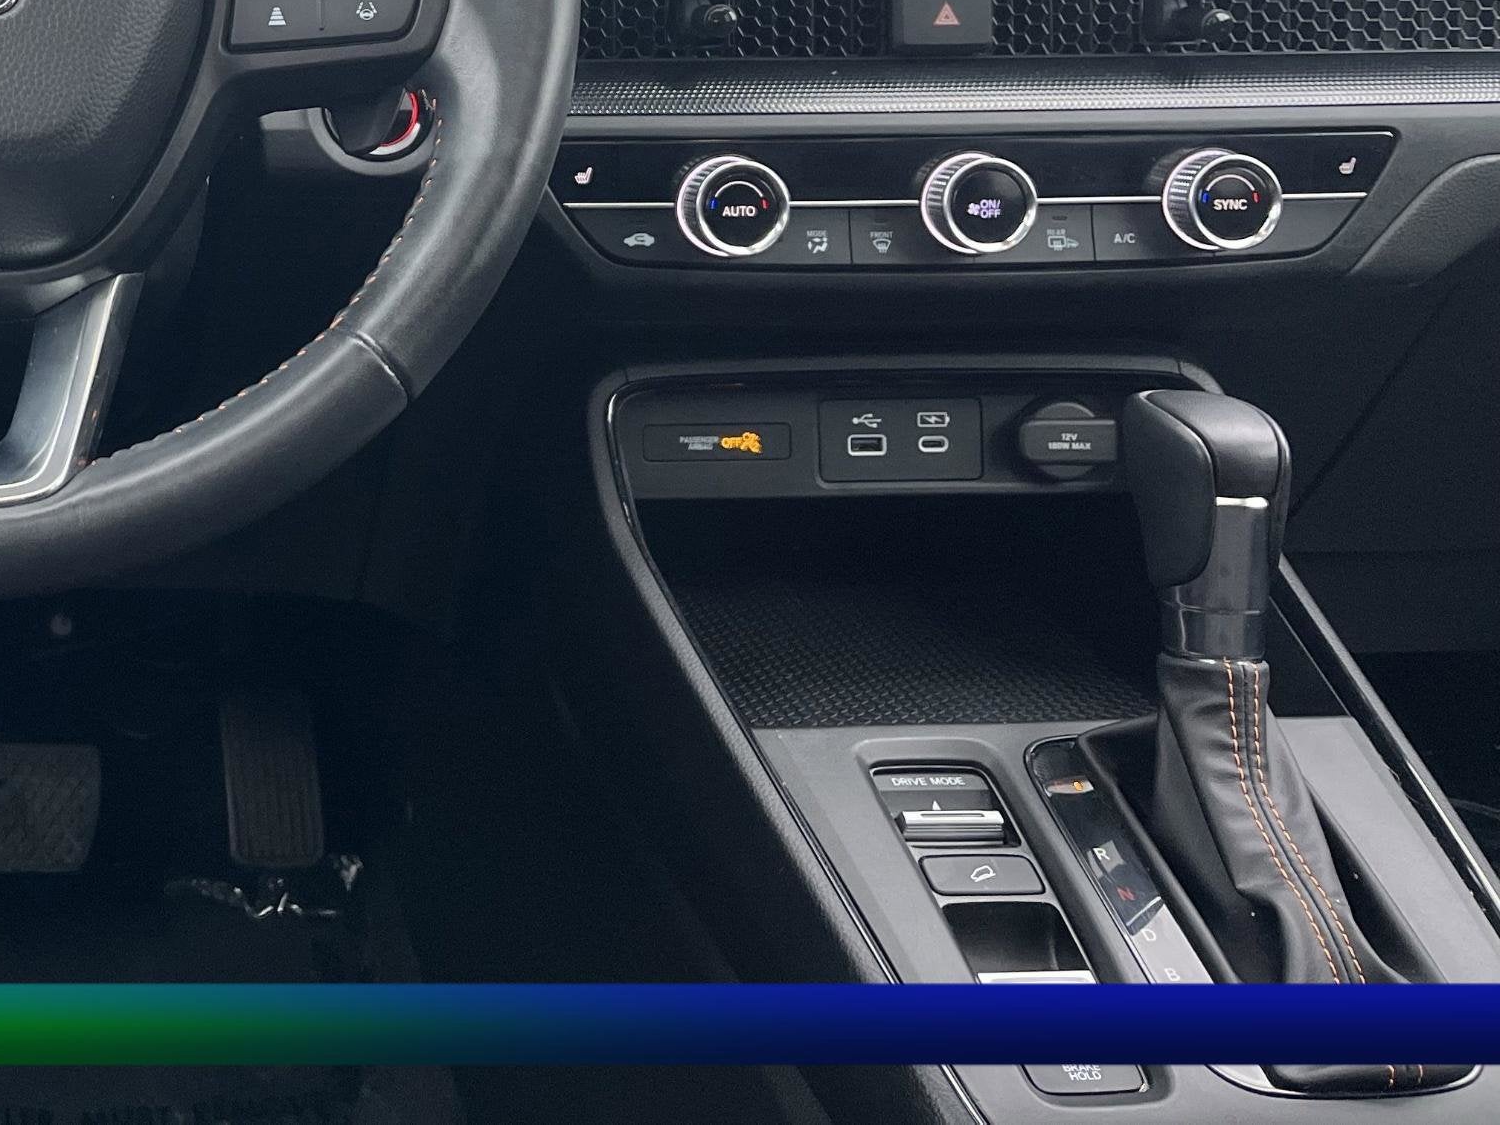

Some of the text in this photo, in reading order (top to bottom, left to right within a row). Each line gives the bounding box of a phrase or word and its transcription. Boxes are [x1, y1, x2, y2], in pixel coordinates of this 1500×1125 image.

[980, 199, 1001, 209] ON/
[1213, 198, 1248, 211] SYNC
[722, 205, 756, 217] AUTO
[980, 208, 1001, 218] OFF
[1113, 233, 1136, 244] A/C
[1061, 433, 1078, 441] 12V
[1071, 442, 1092, 450] MAX
[891, 777, 966, 786] DRIVE MODE
[1093, 847, 1111, 860] R
[1116, 886, 1137, 901] N
[1141, 928, 1157, 942] D
[1164, 967, 1181, 982] B
[1068, 1072, 1102, 1081] HOLD
